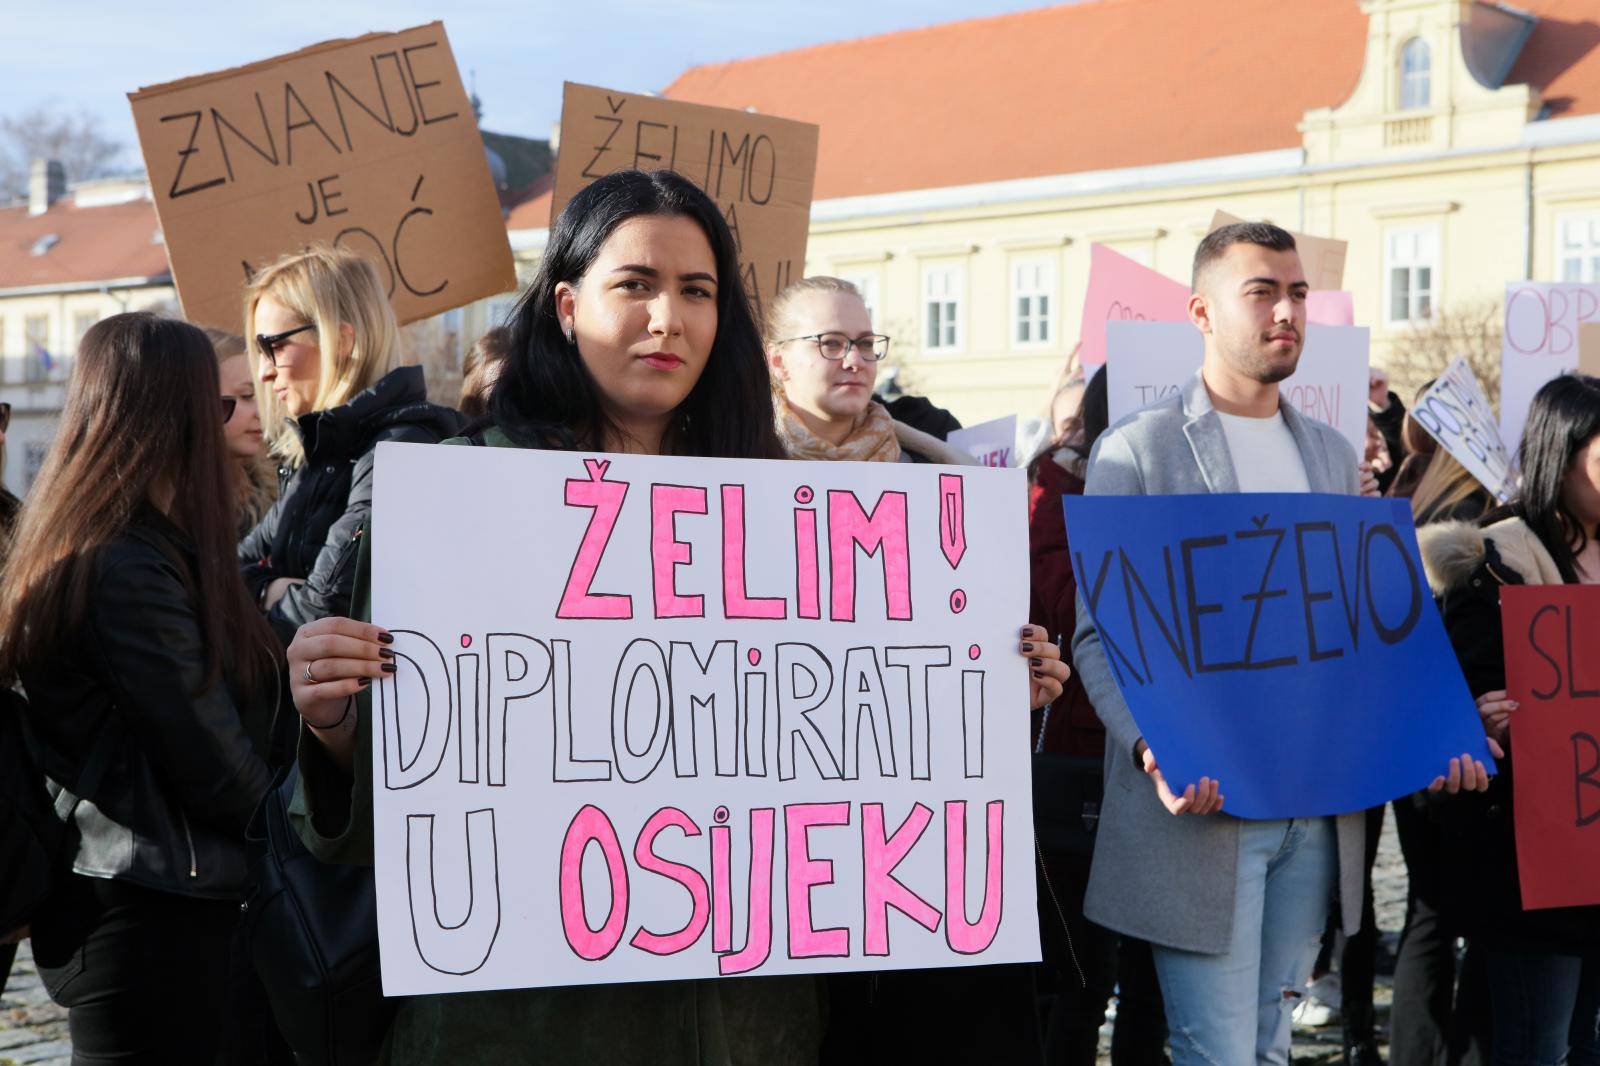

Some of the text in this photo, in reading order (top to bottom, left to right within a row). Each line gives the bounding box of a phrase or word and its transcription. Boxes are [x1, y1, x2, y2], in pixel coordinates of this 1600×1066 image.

[160, 41, 460, 199] ZNANJE
[241, 174, 449, 297] OĆ
[295, 174, 349, 225] JE
[1074, 513, 1423, 688] KNEŽEVO
[406, 807, 501, 976] U
